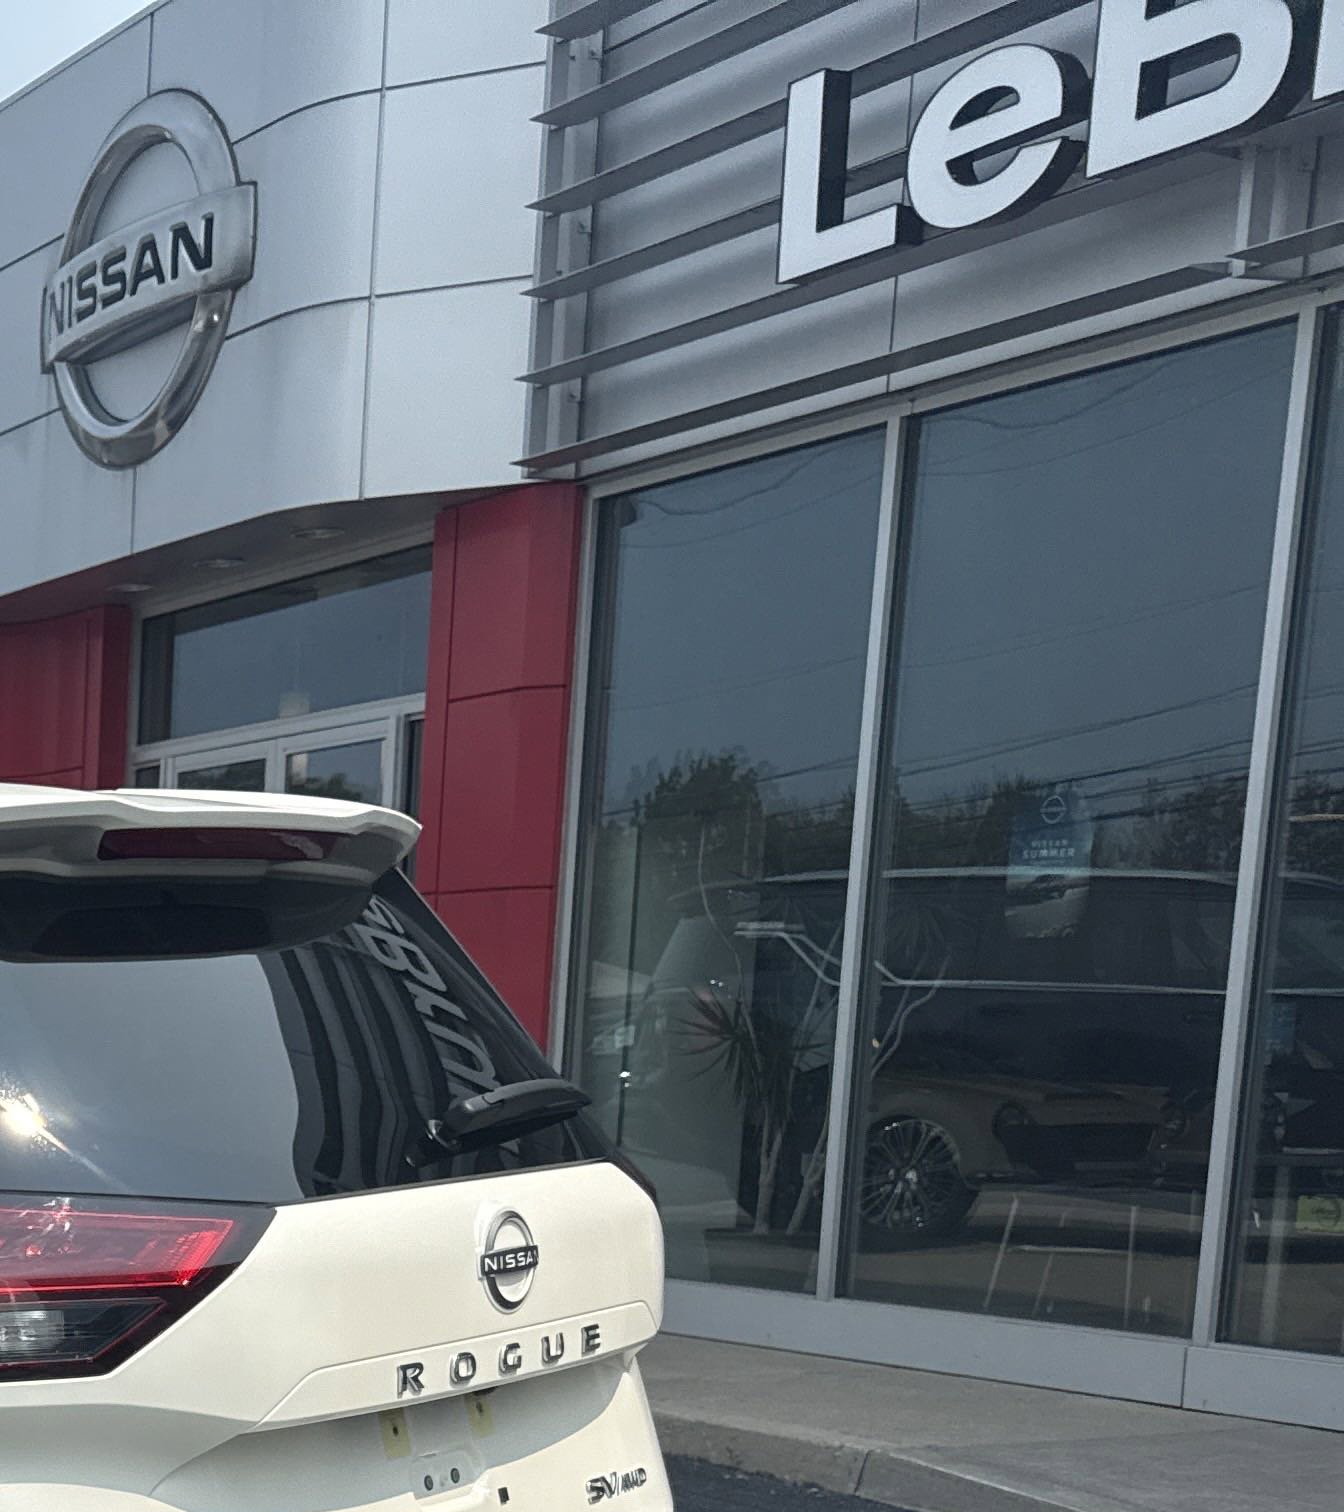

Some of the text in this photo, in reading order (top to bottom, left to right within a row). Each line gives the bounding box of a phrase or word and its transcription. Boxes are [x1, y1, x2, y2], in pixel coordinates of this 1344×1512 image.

[776, 0, 1344, 285] LeB
[48, 211, 214, 335] NISSAN
[1021, 847, 1076, 860] SUMMER
[396, 1324, 601, 1398] ROGUE
